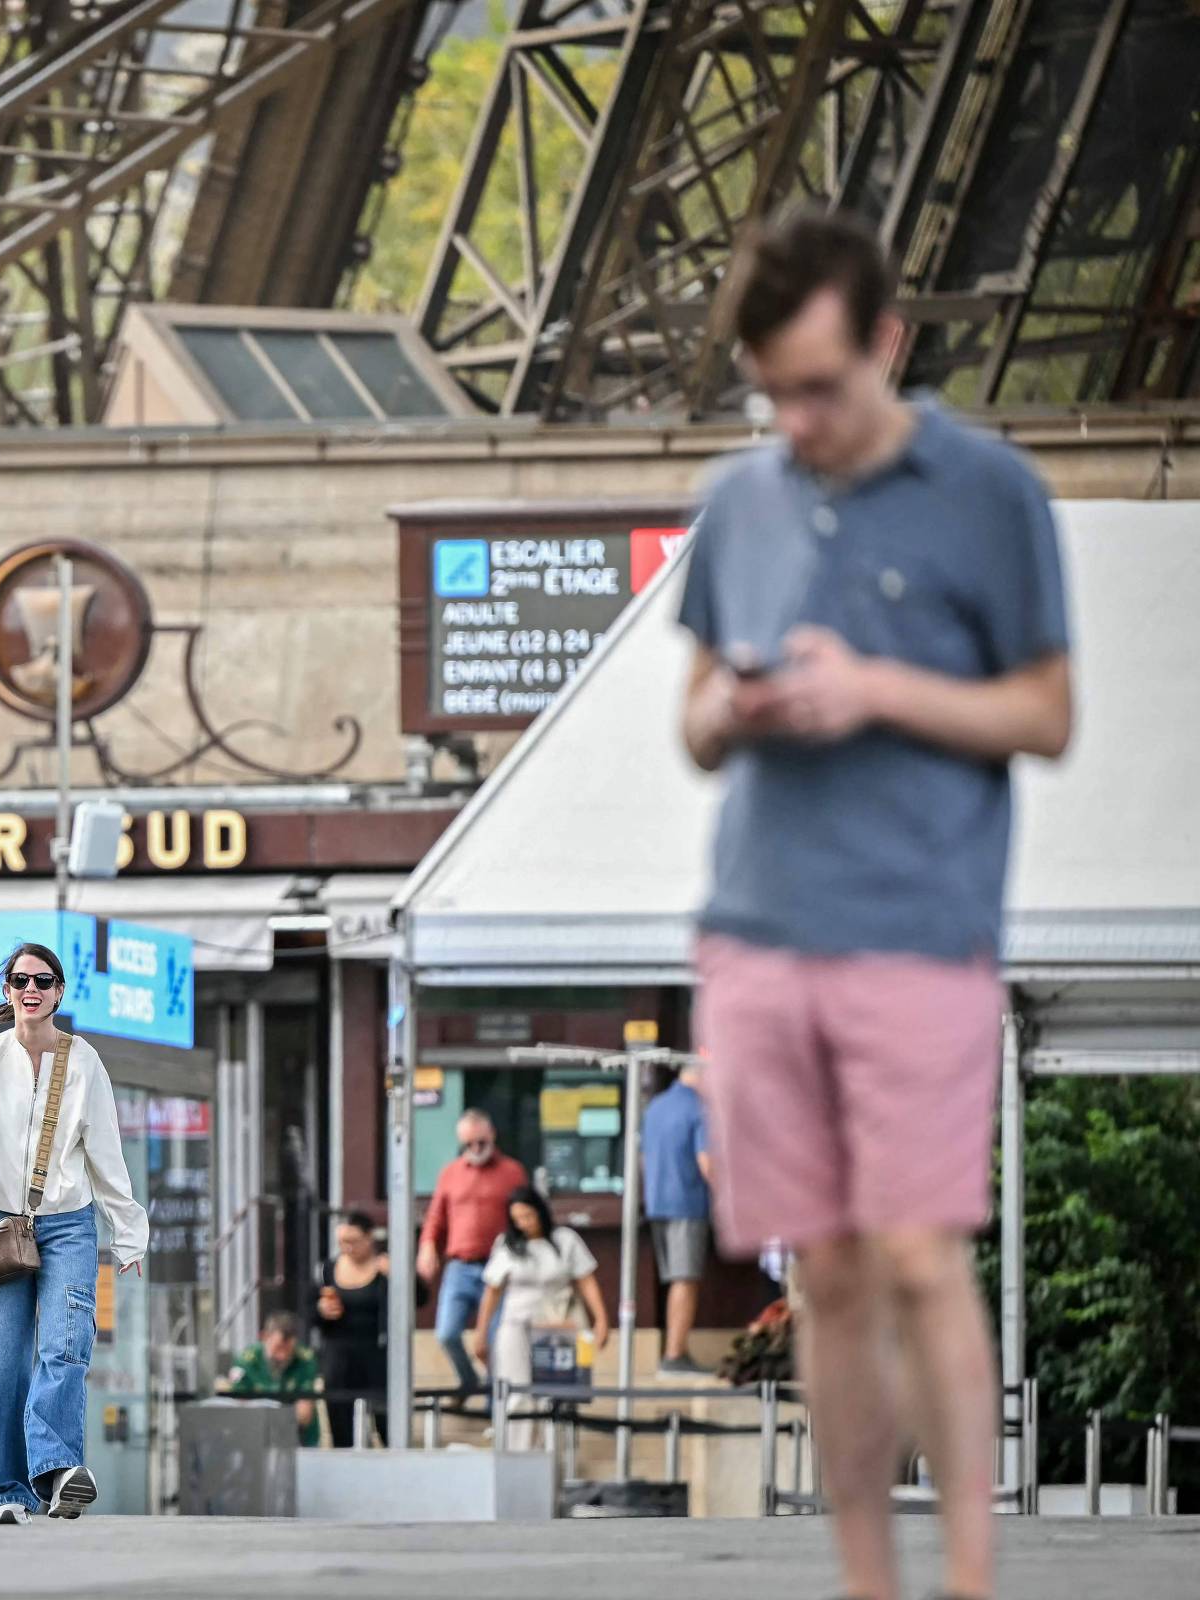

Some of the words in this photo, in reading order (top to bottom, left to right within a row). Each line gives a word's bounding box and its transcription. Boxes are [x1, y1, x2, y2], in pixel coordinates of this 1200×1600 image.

[490, 540, 606, 567] ESCALIER
[442, 602, 520, 625] ADULTE
[444, 630, 509, 655] JEUNE
[509, 630, 545, 656] (12
[563, 629, 590, 653] 24
[443, 659, 521, 684] ENFANT
